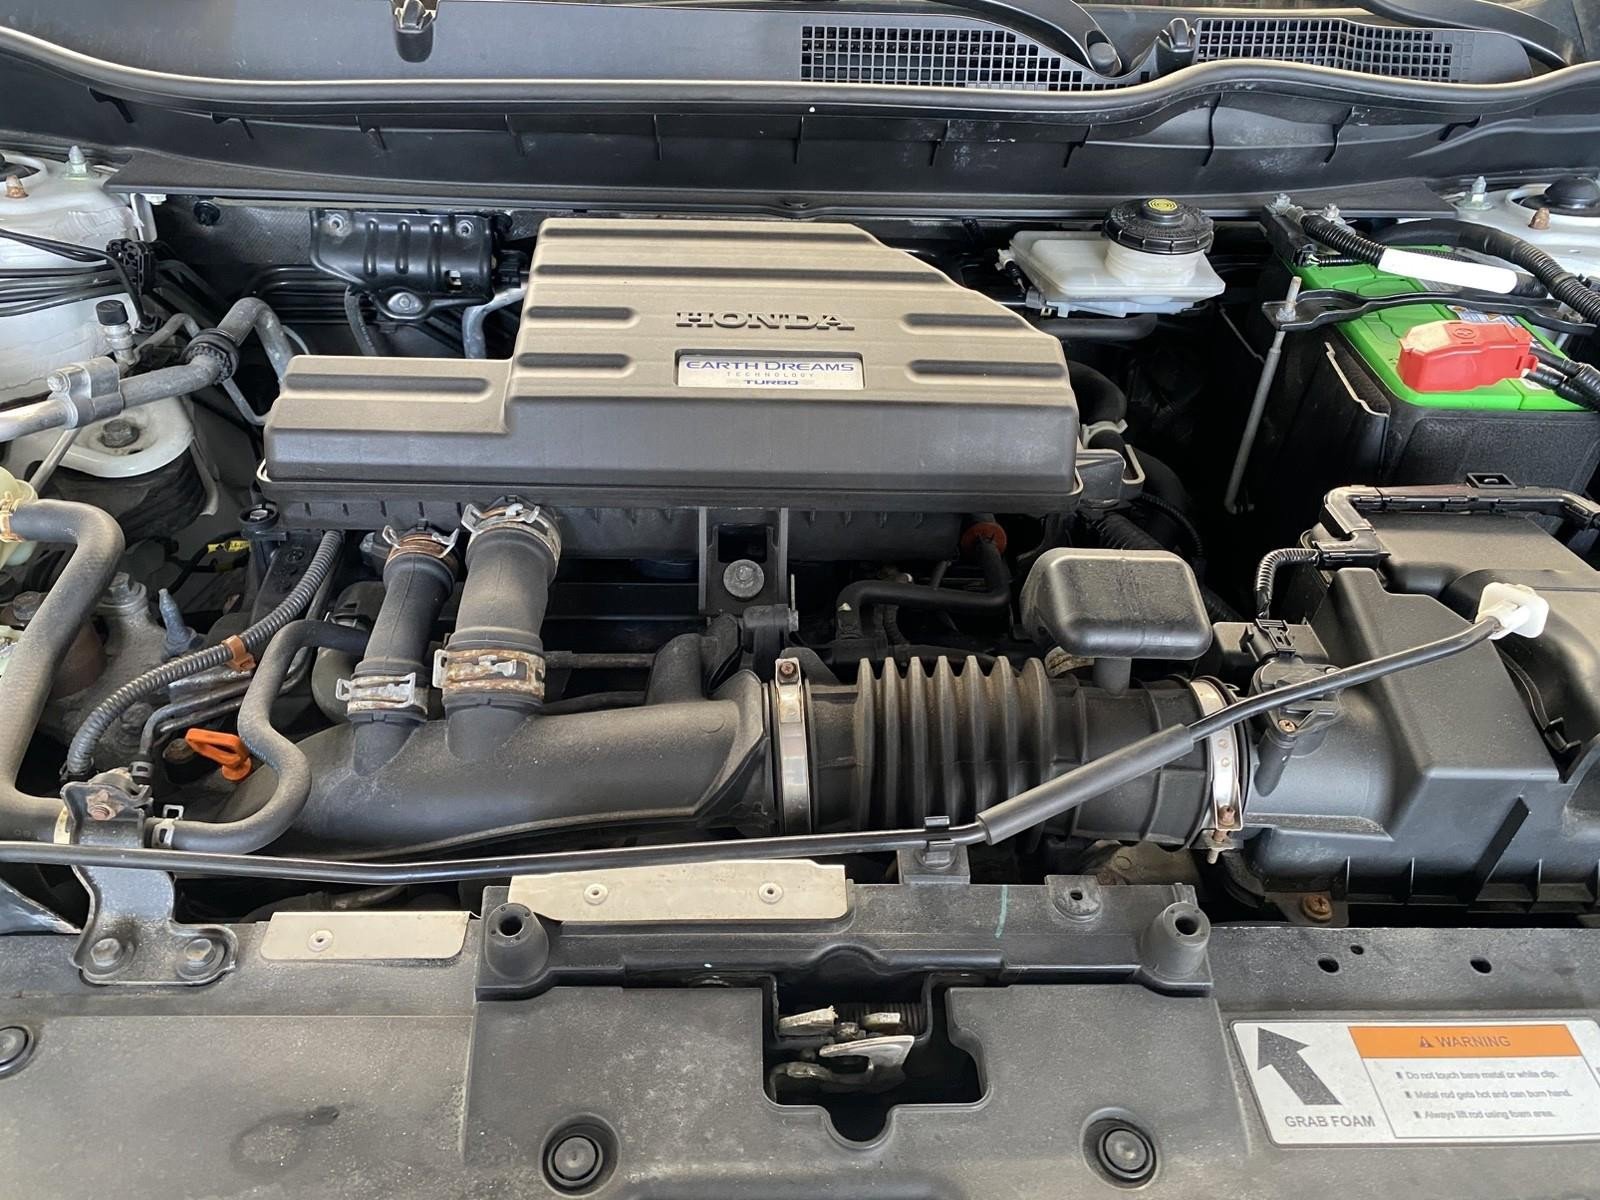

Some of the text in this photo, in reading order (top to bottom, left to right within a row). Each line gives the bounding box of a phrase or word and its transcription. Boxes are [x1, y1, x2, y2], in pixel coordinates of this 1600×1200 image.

[676, 312, 855, 331] HONDA
[686, 360, 855, 371] EARTH DREAMS
[1436, 1035, 1511, 1048] WARNING
[1405, 1071, 1420, 1080] Do
[1435, 1071, 1460, 1079] touch
[1285, 1115, 1376, 1128] GRAB FOAM
